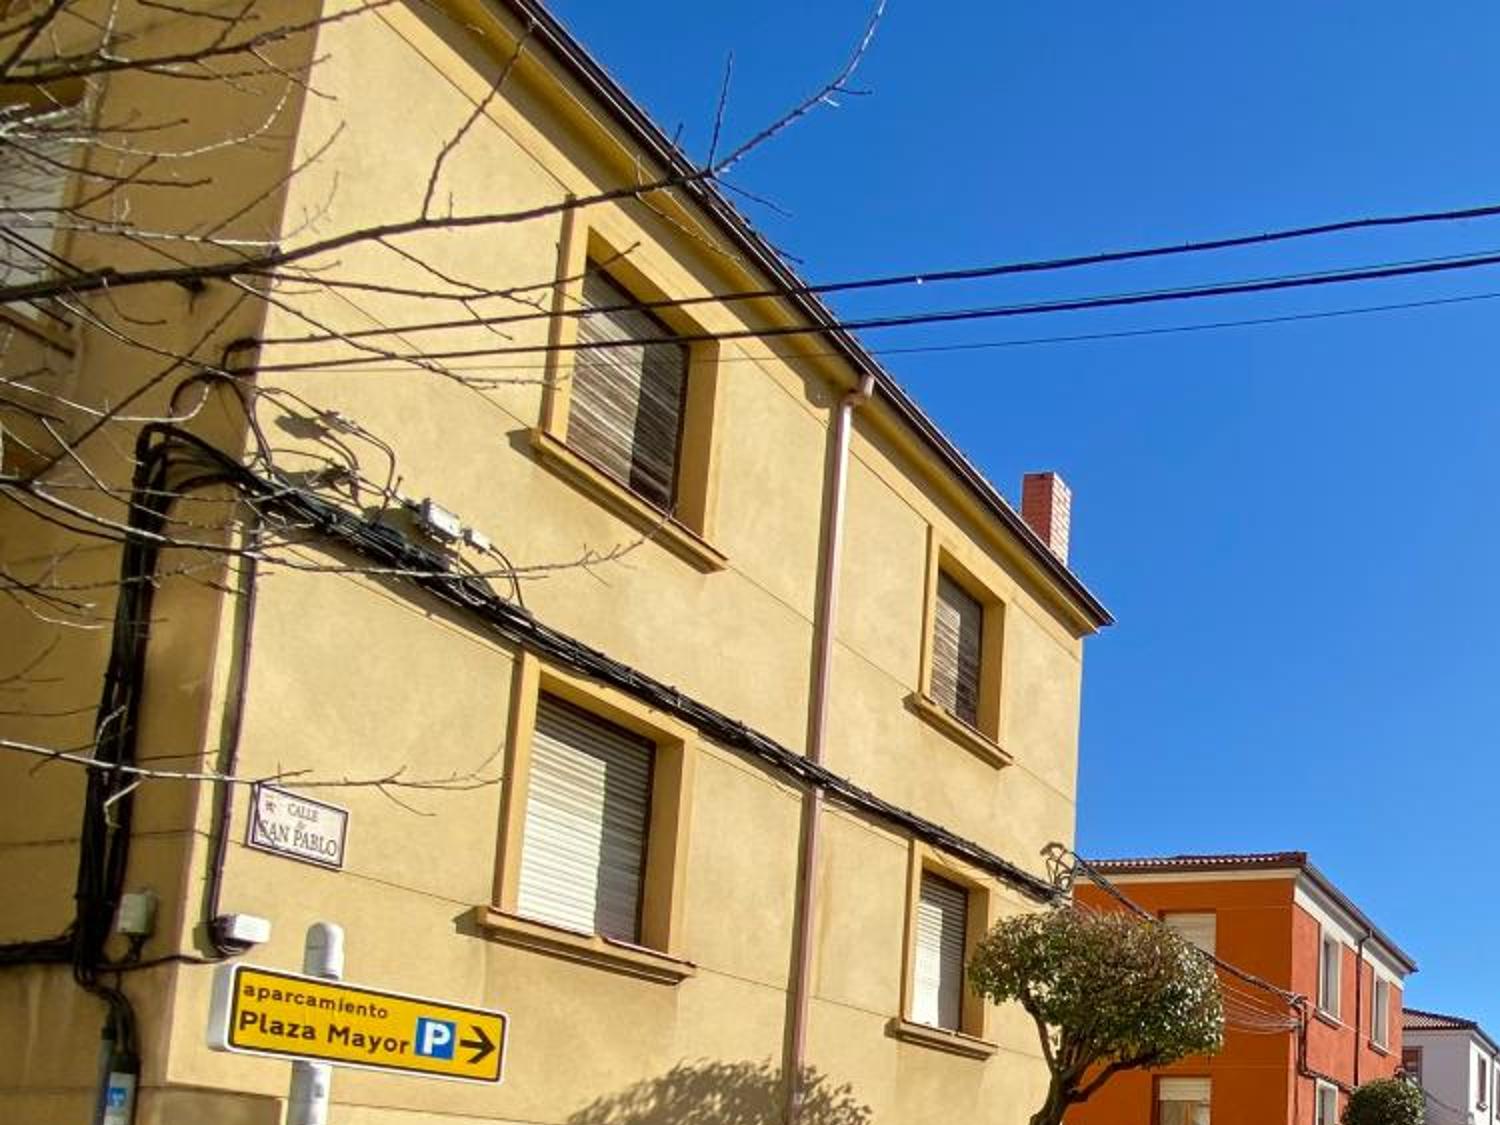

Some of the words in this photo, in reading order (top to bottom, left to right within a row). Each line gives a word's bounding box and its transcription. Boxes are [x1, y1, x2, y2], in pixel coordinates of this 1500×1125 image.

[287, 803, 319, 823] CALLE
[259, 820, 290, 844] SAN
[292, 829, 338, 857] PABLO
[243, 985, 389, 1020] aparcamiento
[239, 1010, 318, 1041] Plaza
[327, 1023, 411, 1055] Mayor
